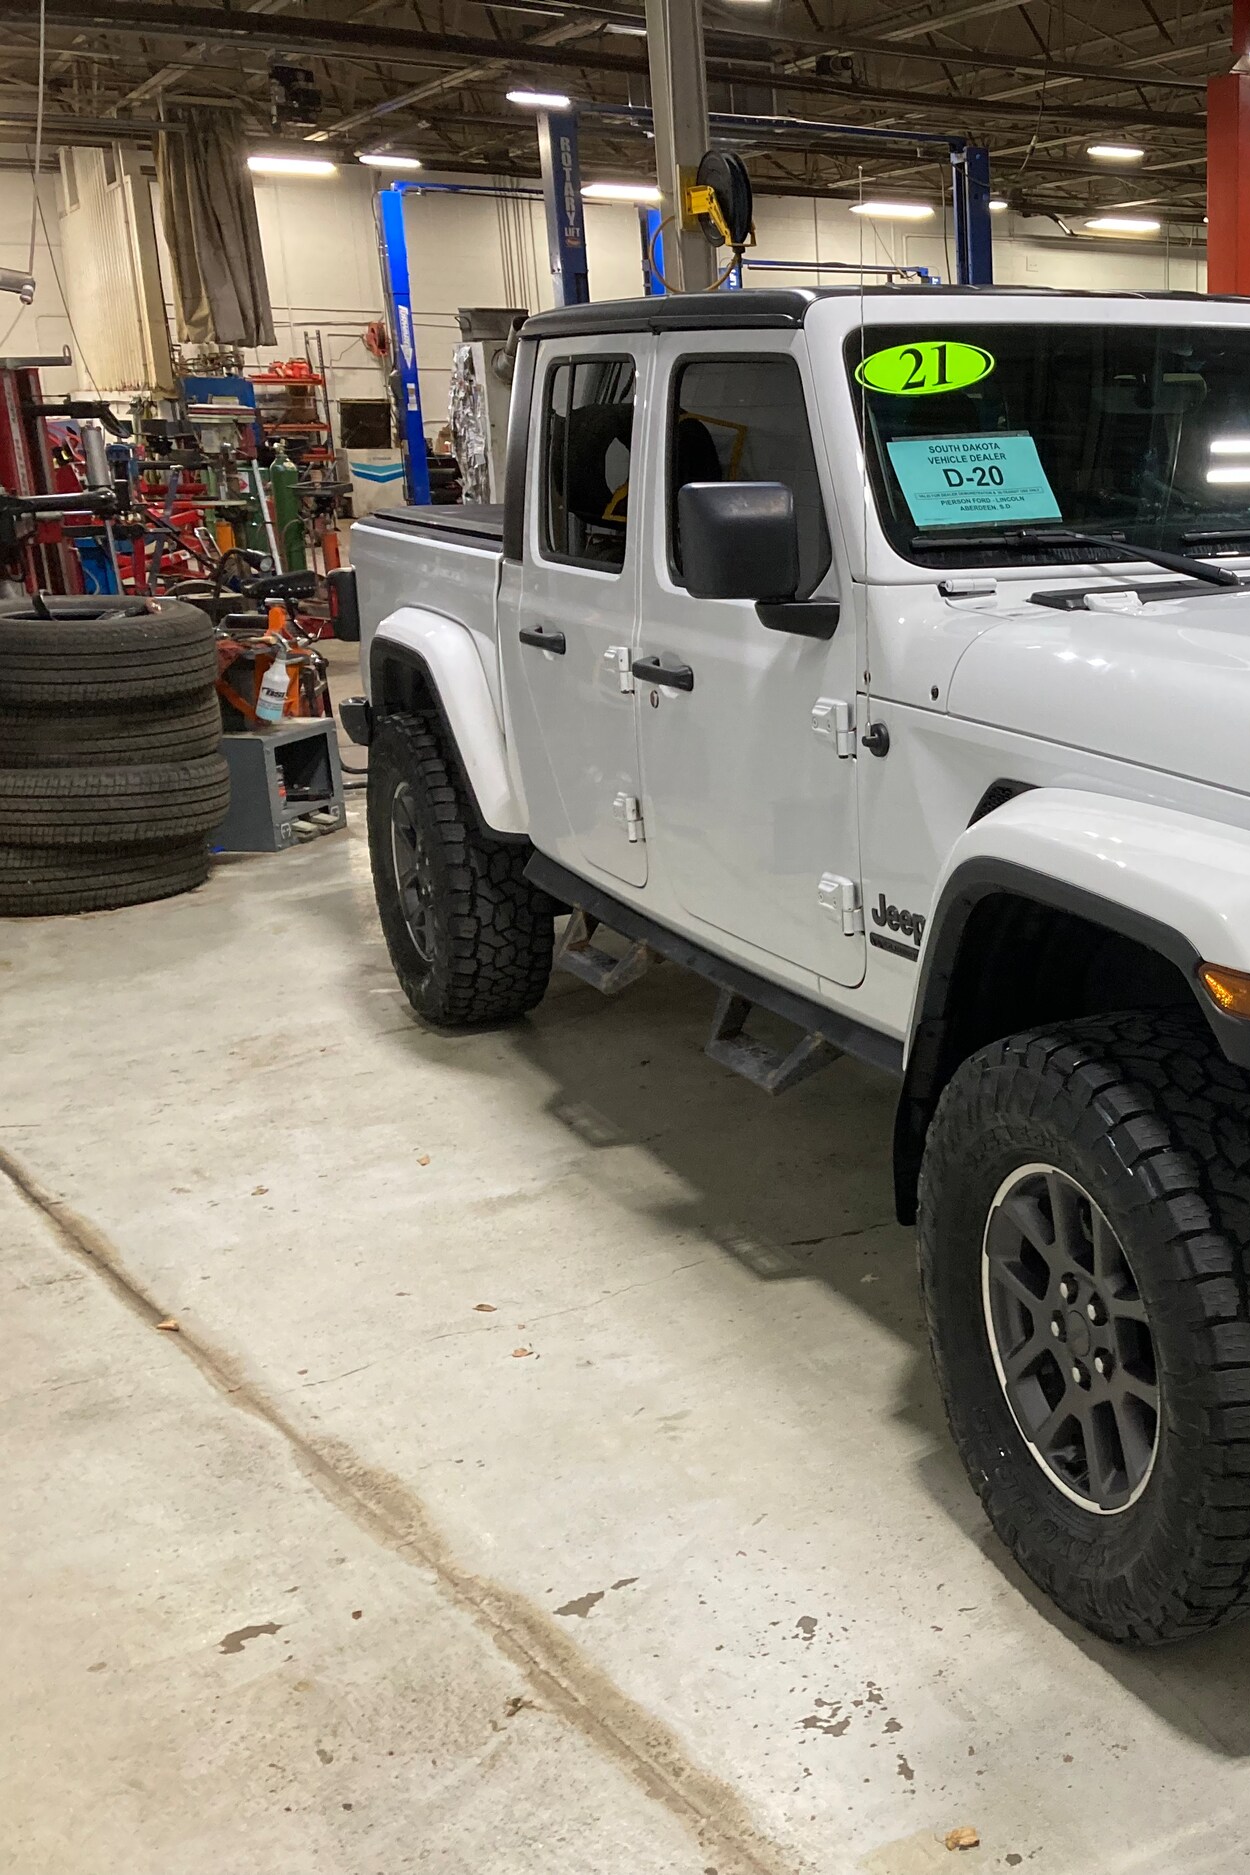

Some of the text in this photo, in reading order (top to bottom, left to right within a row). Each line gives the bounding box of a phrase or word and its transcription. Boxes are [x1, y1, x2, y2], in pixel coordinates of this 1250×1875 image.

[560, 136, 576, 226] ROTARY
[564, 227, 580, 237] LIFT
[899, 343, 953, 391] 21
[928, 442, 1001, 454] SOUTH DAKOTA
[927, 452, 1007, 465] VEHICLE DEALER
[942, 465, 1004, 487] D-20
[940, 498, 972, 506] PIERSON
[871, 893, 926, 947] Jeep
